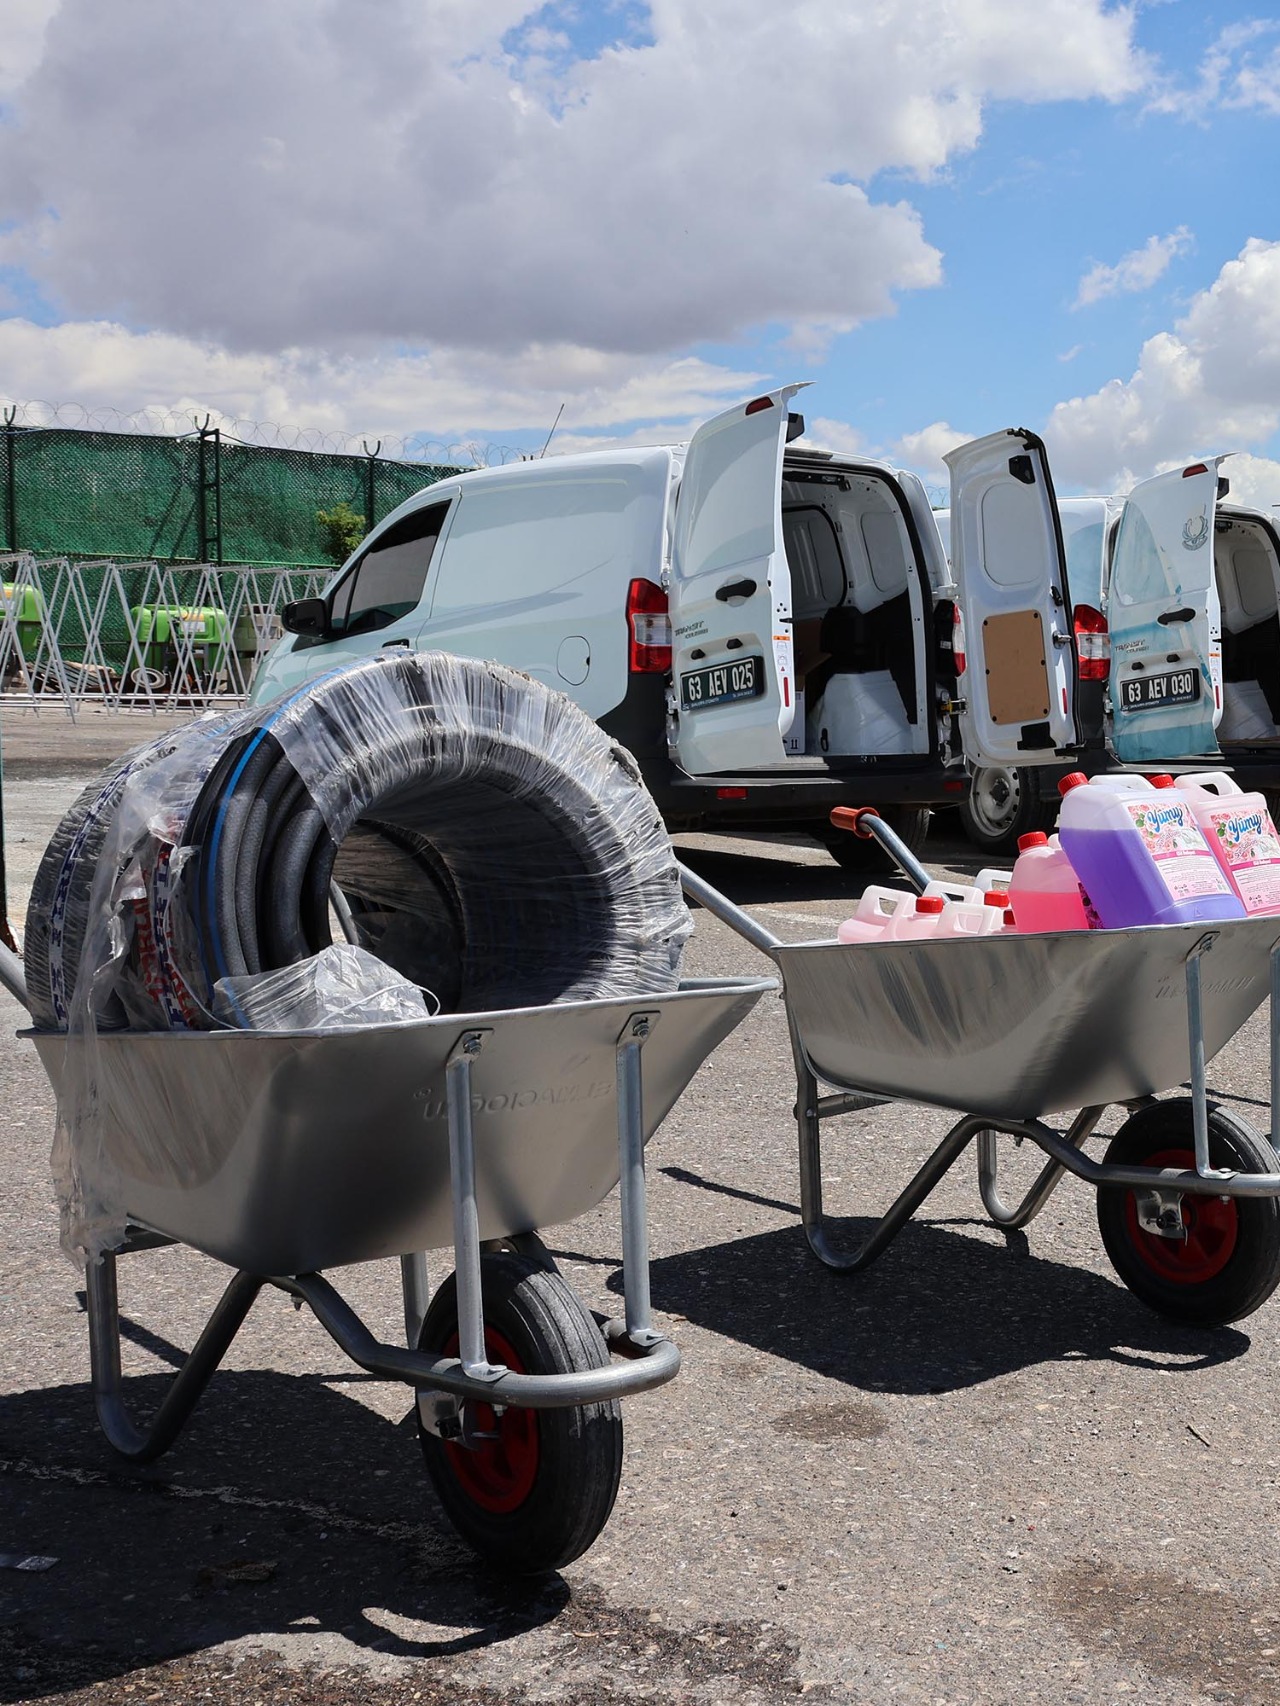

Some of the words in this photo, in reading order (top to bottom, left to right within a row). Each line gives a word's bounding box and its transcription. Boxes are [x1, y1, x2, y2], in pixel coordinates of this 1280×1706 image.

[688, 677, 702, 701] 63
[709, 669, 728, 697] AEV
[731, 664, 753, 691] 025
[1128, 683, 1141, 703] 63
[1148, 678, 1166, 699] AEV
[1171, 674, 1191, 695] 030
